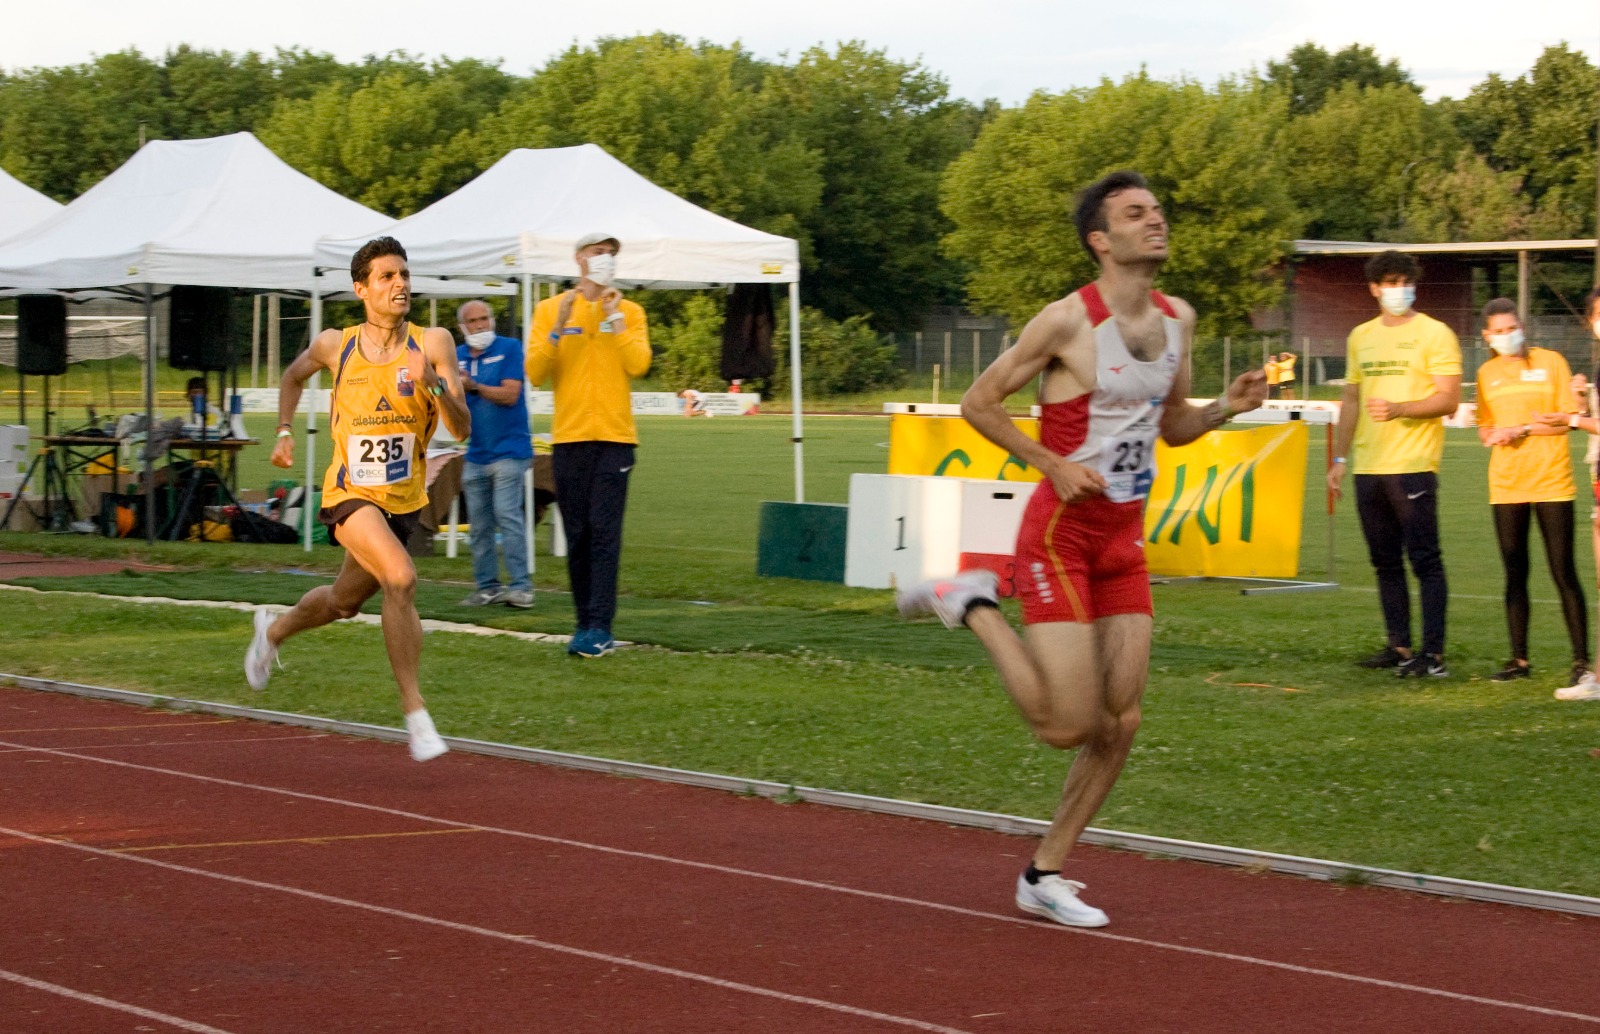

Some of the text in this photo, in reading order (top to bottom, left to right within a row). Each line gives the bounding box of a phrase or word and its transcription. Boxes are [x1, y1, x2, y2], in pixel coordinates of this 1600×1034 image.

[360, 437, 404, 463] 235
[1111, 441, 1144, 473] 23
[893, 516, 908, 551] 1
[1003, 562, 1017, 599] 3
